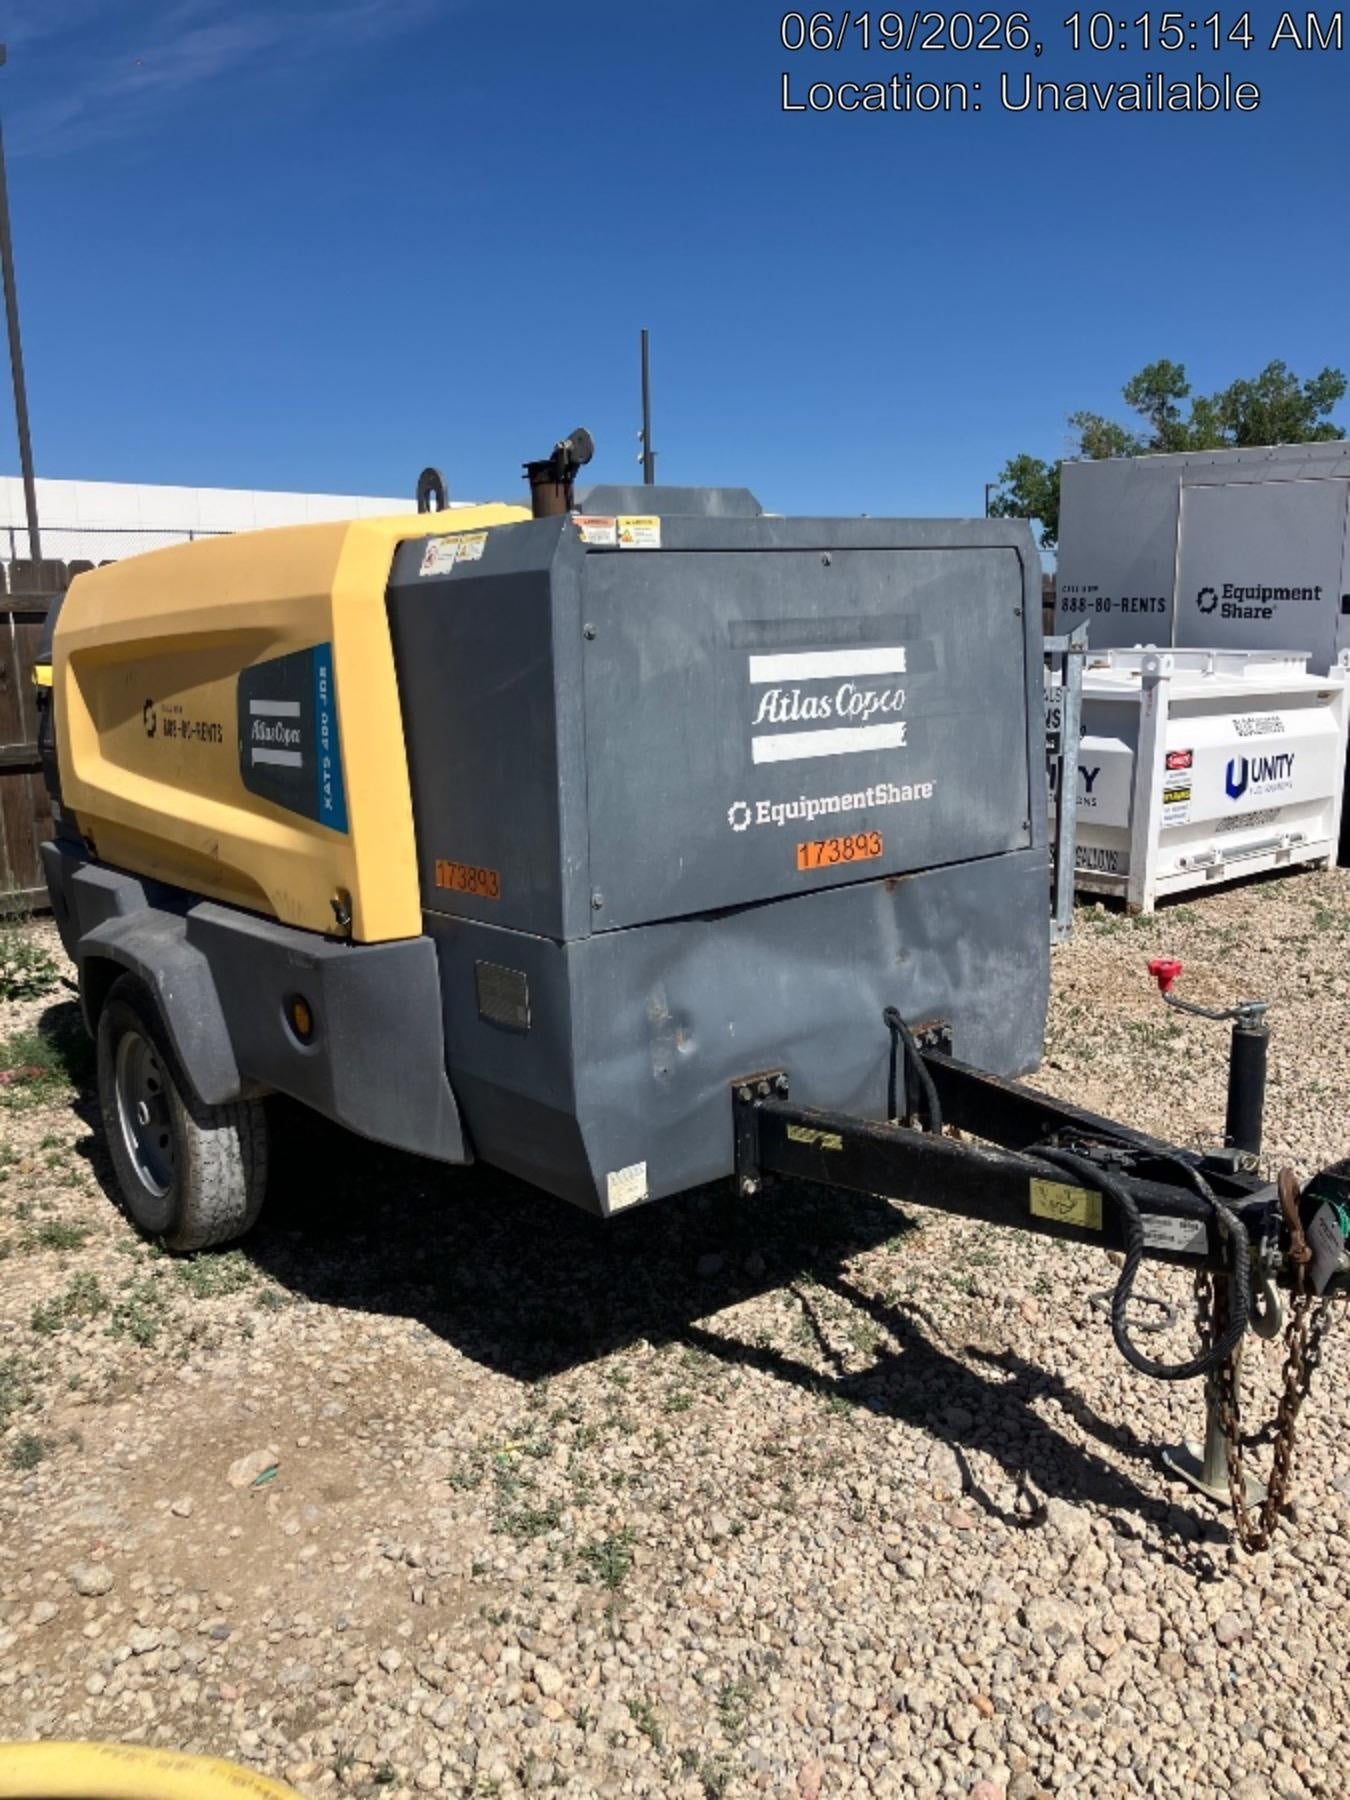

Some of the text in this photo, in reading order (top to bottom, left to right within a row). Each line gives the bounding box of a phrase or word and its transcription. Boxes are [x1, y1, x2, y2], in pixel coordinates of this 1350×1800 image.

[1061, 596, 1167, 613] 888-80-RENTS
[1222, 584, 1322, 602] Equipment
[1221, 603, 1273, 619] Share
[752, 682, 906, 725] Atlas Copco
[1251, 752, 1295, 782] UNITY
[755, 781, 934, 826] EquipmentShare
[799, 832, 882, 866] 173893
[436, 862, 499, 897] 173893
